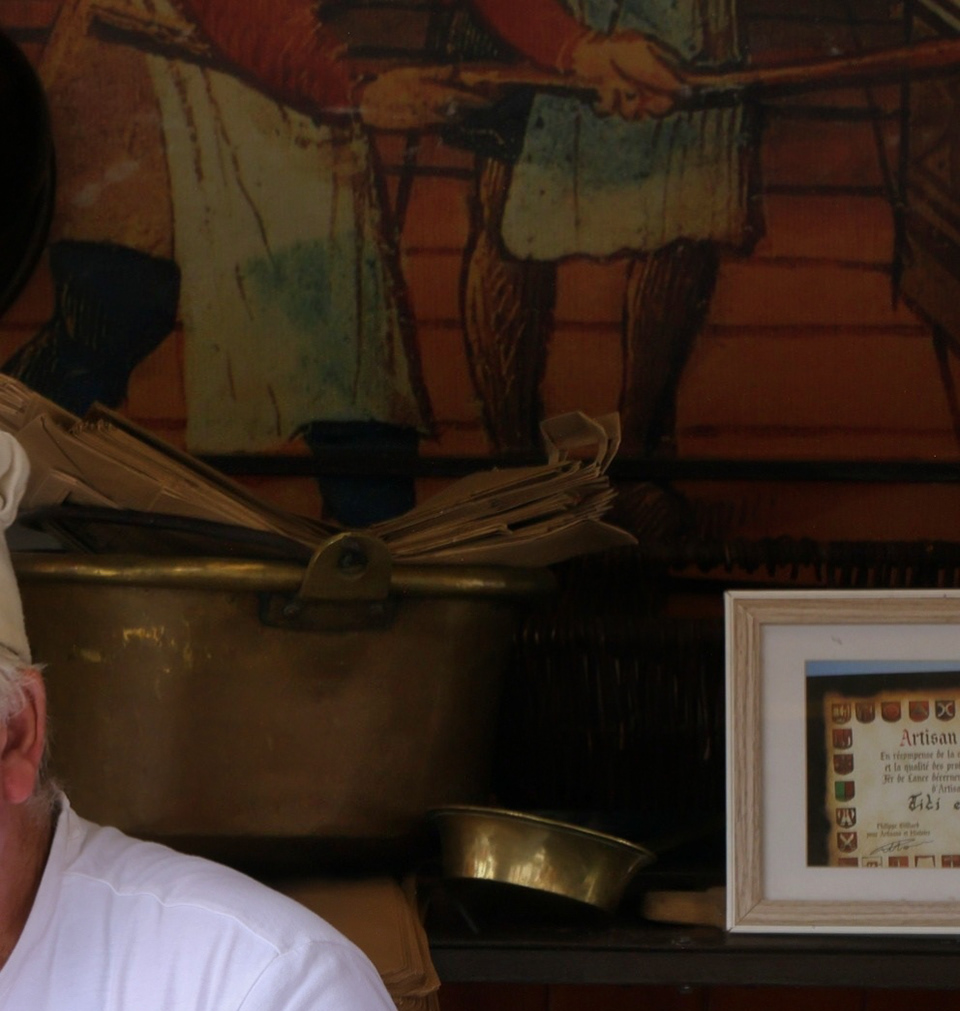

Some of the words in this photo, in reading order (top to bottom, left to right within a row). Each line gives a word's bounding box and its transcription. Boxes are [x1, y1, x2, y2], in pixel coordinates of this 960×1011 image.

[900, 728, 957, 747] Artisan
[880, 751, 890, 761] En
[936, 749, 944, 759] de
[947, 749, 955, 759] la
[884, 763, 891, 772] et
[894, 762, 901, 772] la
[904, 761, 929, 773] qualité
[897, 773, 905, 783] de
[908, 773, 929, 783] Lance
